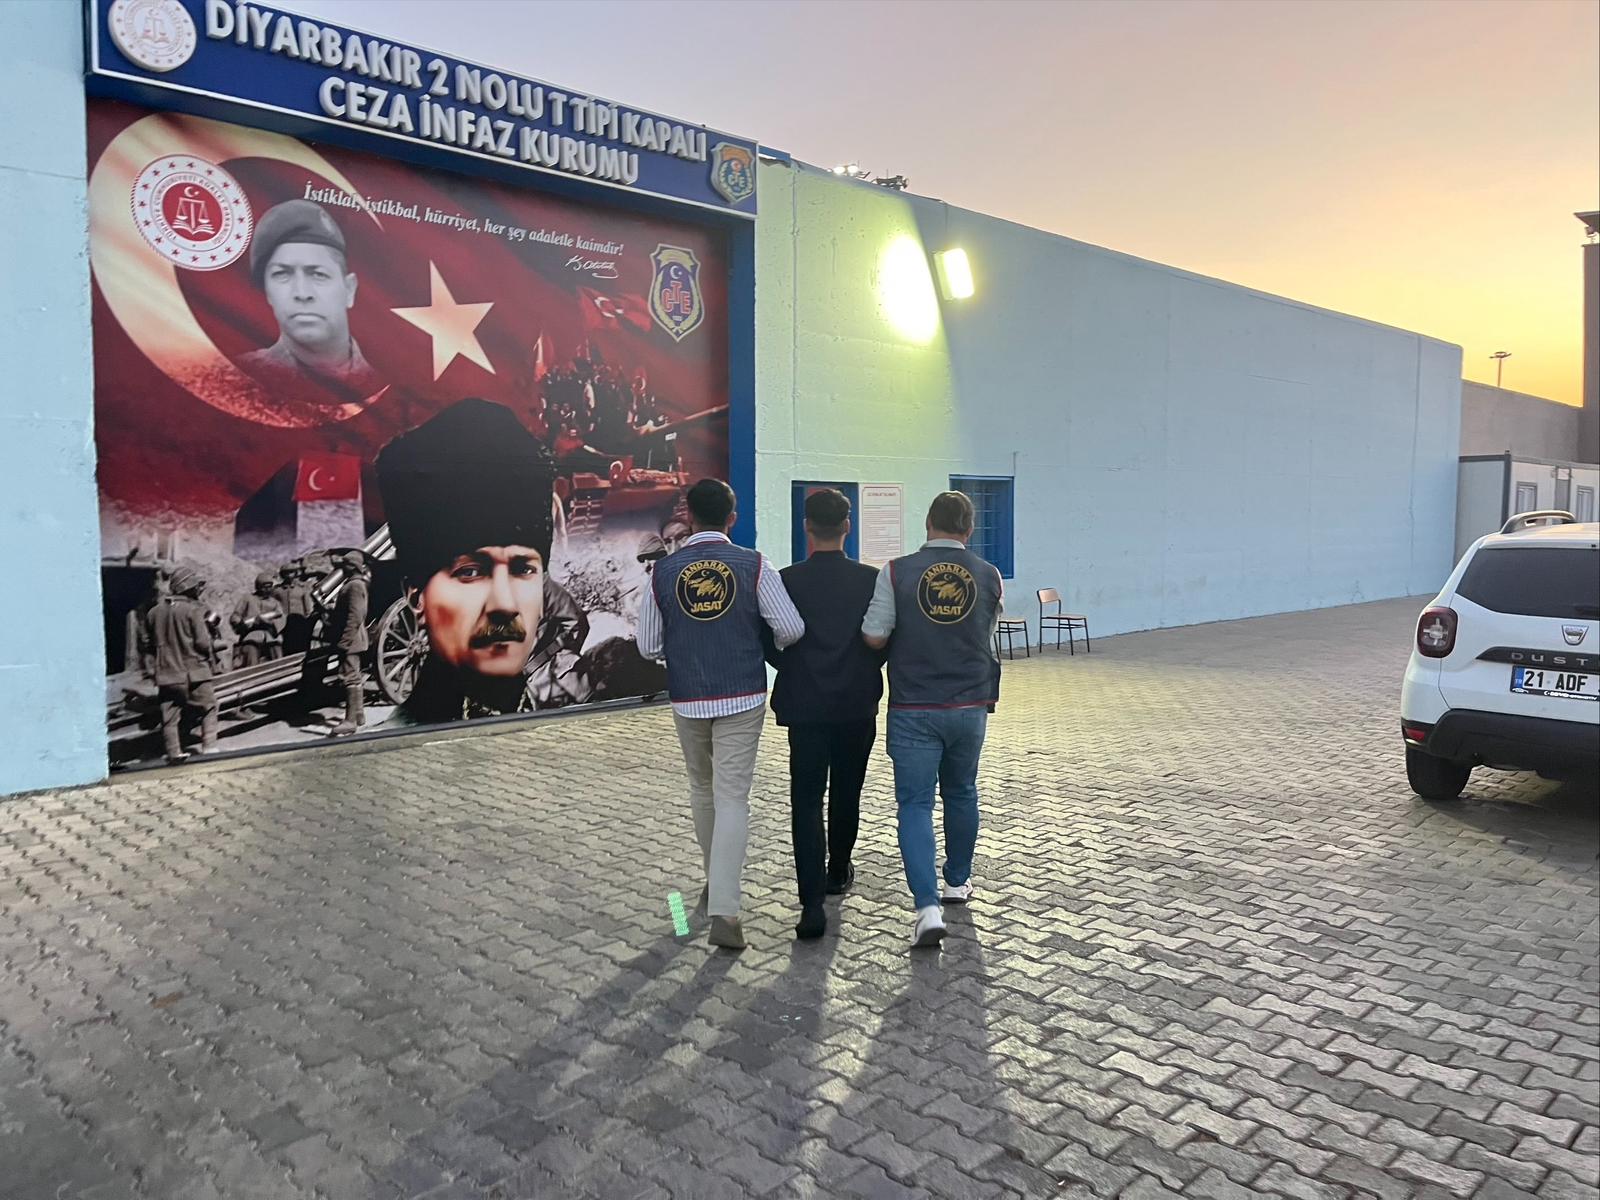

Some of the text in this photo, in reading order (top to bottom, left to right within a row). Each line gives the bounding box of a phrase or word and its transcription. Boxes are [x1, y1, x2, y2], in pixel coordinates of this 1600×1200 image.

[206, 0, 423, 89] DİYARBAKIR
[427, 58, 449, 96] 2
[455, 65, 544, 121] NOLU
[548, 91, 568, 127] T
[569, 94, 619, 141] TİPİ
[622, 111, 707, 162] KAPALI
[319, 77, 639, 185] CEZA İNFAZ KURUMU
[303, 181, 624, 256] İstiklal, istikbal, hürriyet, her şey adaletle kaimdir!
[681, 561, 730, 582] JANDARMA
[925, 564, 972, 584] JANDARMA
[690, 600, 723, 613] JASAT
[930, 605, 963, 616] JASAT
[1524, 670, 1588, 692] 21 ADF
